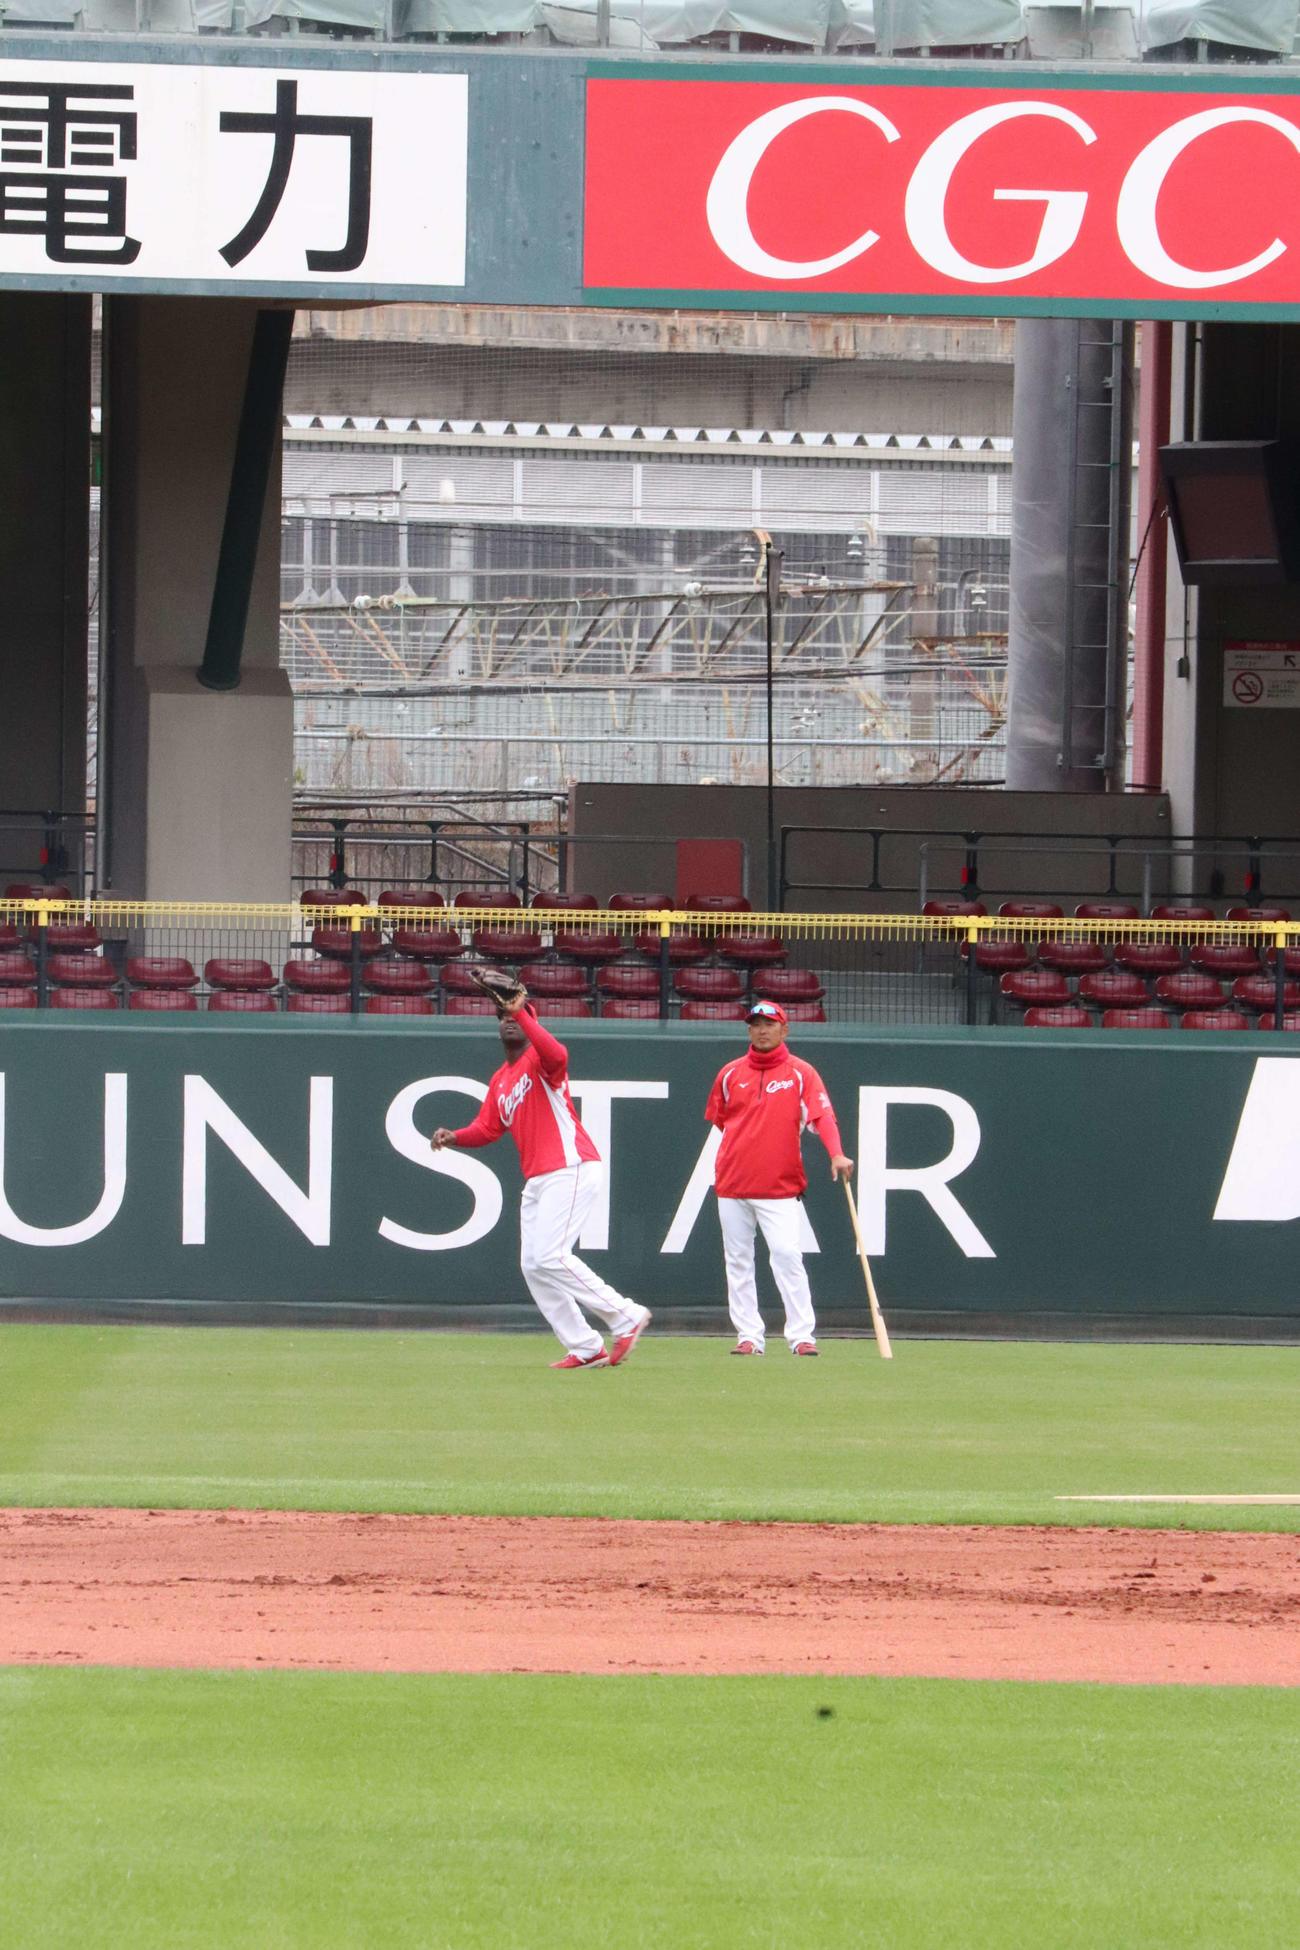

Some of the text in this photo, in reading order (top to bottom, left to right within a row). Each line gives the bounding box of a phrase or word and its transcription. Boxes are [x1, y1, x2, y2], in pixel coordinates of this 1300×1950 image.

[0, 80, 373, 272] 電力
[706, 96, 1300, 288] CGC
[497, 1073, 533, 1127] Carp
[765, 1079, 795, 1094] Carp
